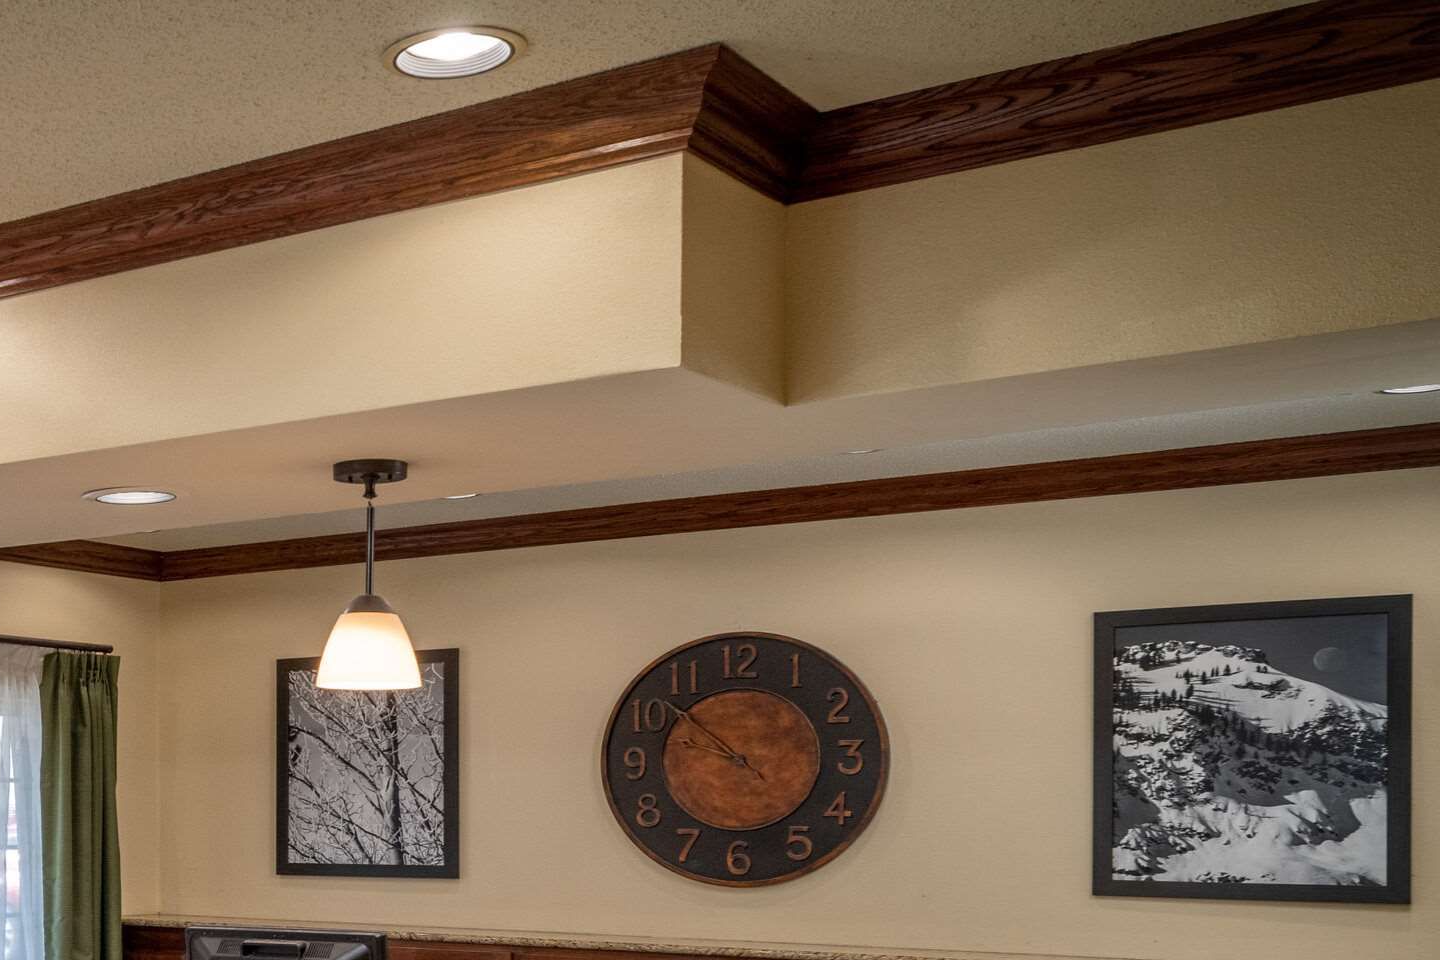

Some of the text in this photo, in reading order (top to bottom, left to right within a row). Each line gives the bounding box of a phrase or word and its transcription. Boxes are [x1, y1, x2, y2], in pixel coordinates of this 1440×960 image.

[670, 659, 697, 696] 11
[720, 643, 759, 679] 12
[789, 653, 802, 688] 1
[631, 698, 668, 734] 10
[826, 687, 850, 724] 2
[623, 746, 647, 780] 9
[836, 739, 864, 775] 3
[636, 793, 661, 828] 8
[823, 791, 853, 825] 4
[676, 828, 702, 863] 7
[726, 840, 752, 876] 6
[785, 825, 812, 861] 5
